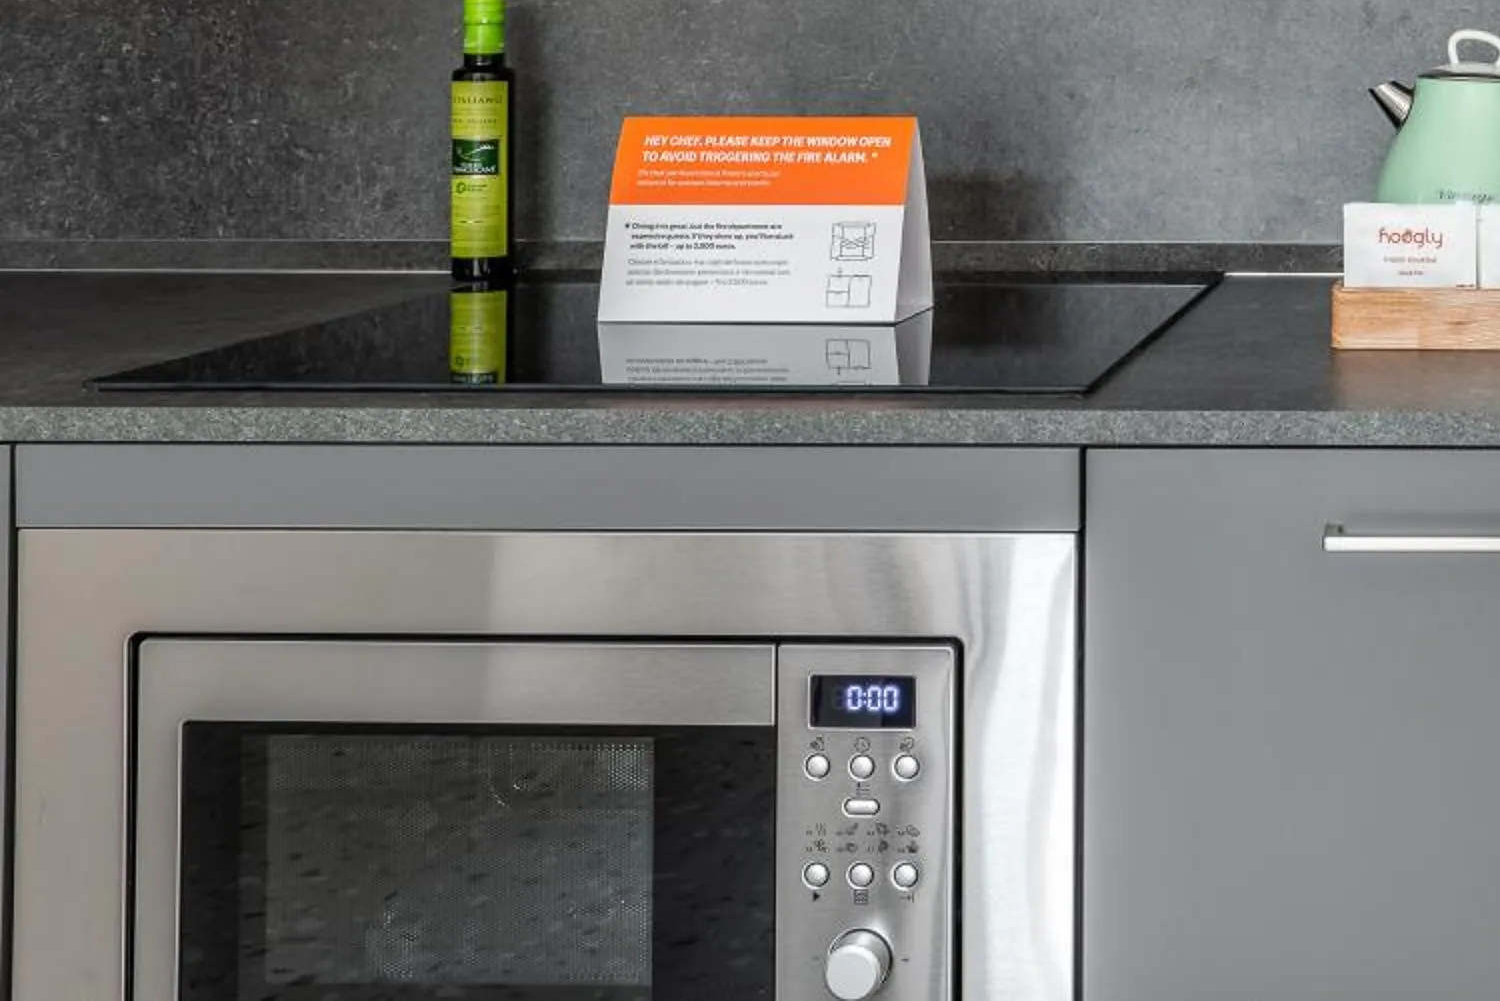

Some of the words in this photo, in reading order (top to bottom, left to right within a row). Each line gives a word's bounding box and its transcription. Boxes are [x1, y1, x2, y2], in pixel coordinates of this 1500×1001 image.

[644, 135, 668, 148] HEY
[704, 135, 749, 148] PLEASE
[750, 135, 781, 148] KEEP
[782, 135, 805, 148] THE
[807, 135, 859, 148] WINDOW
[860, 135, 892, 148] OPEN
[643, 151, 659, 164] TO
[660, 151, 697, 164] AVOID
[701, 151, 770, 164] TRIGGERING
[773, 151, 796, 164] THE
[797, 151, 822, 164] FIRE
[1379, 226, 1443, 250] hoogly
[847, 685, 898, 711] 0:00
